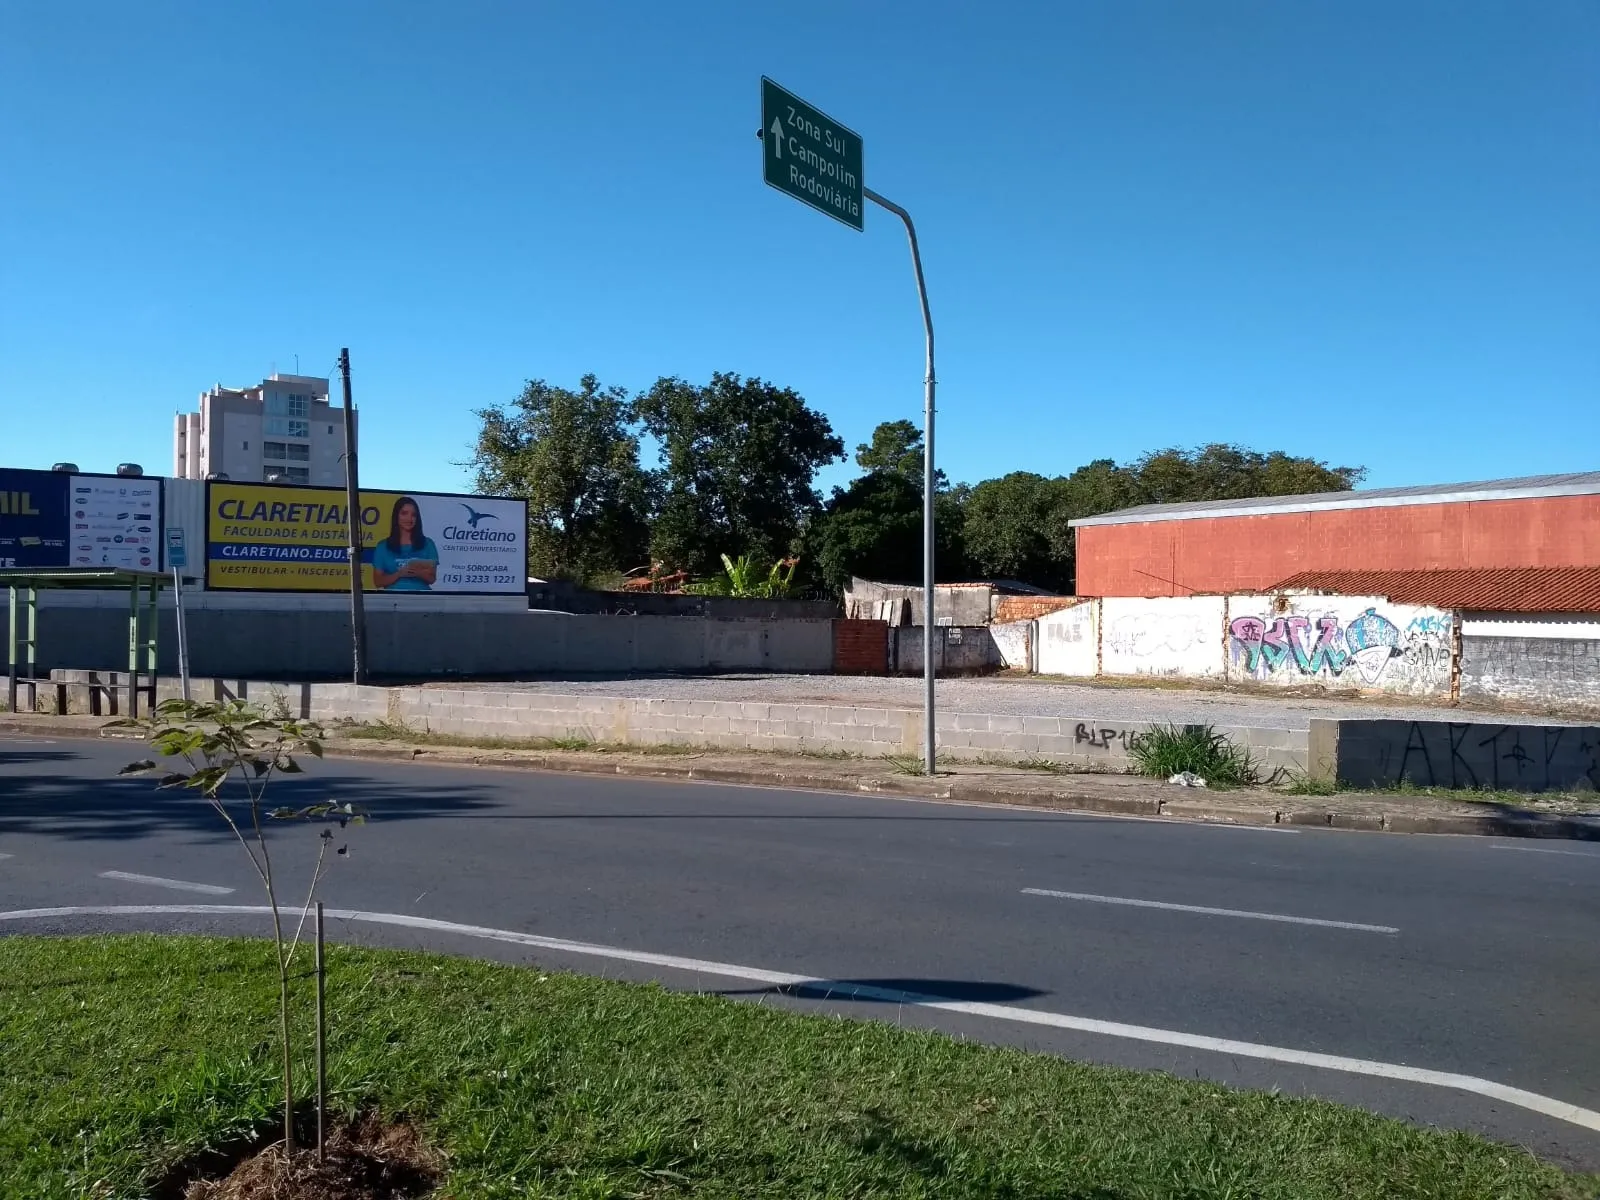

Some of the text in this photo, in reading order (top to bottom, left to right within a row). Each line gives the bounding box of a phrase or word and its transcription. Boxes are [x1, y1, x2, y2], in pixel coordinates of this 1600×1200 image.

[787, 105, 846, 157] Zona Sul
[788, 136, 856, 189] Campolim
[789, 164, 859, 217] Rodoviária
[223, 525, 298, 538] FACULDADE
[300, 527, 308, 538] A
[443, 526, 516, 543] Claretiano
[443, 544, 469, 552] CENTRO
[220, 565, 287, 575] VESTIBULAR
[466, 564, 508, 572] SOROCABA
[443, 574, 516, 584] (15) 3233 1221
